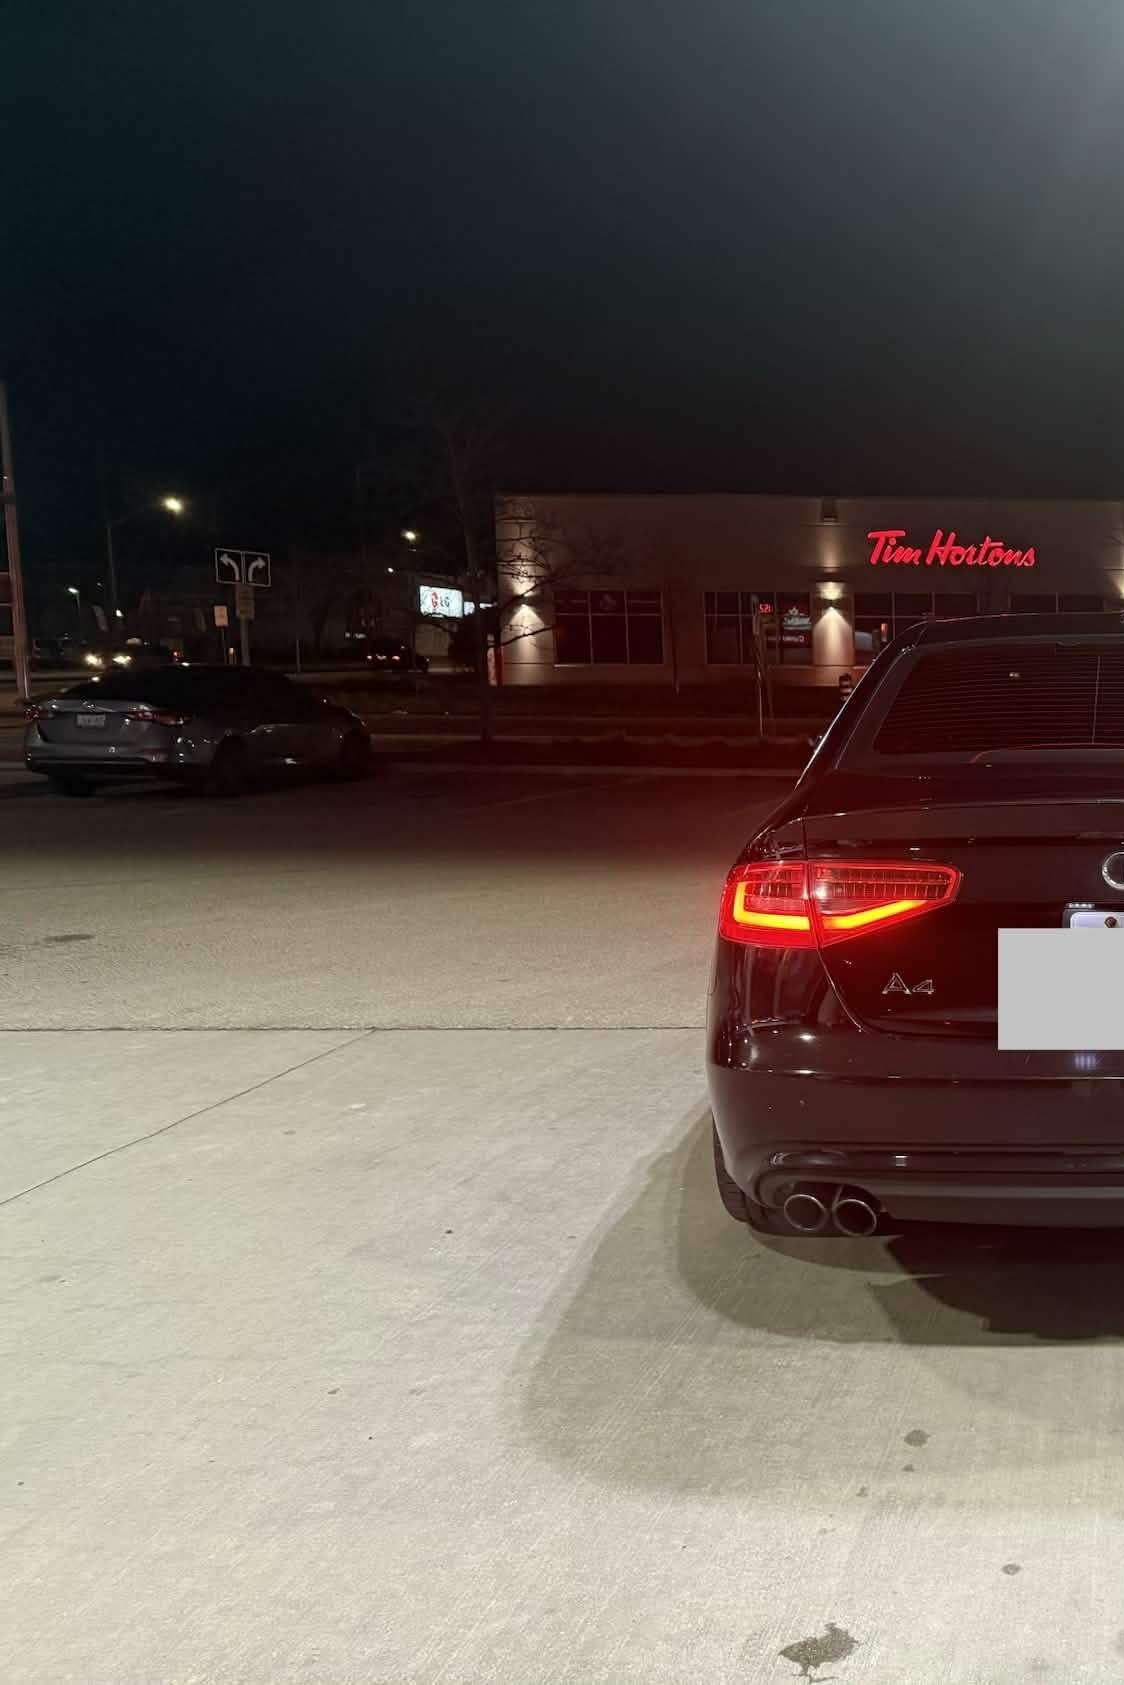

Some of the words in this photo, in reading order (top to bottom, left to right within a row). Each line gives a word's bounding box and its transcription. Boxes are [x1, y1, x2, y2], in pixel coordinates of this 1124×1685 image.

[867, 530, 922, 566] Tim
[925, 529, 1036, 567] Hortons
[882, 972, 935, 995] A4
